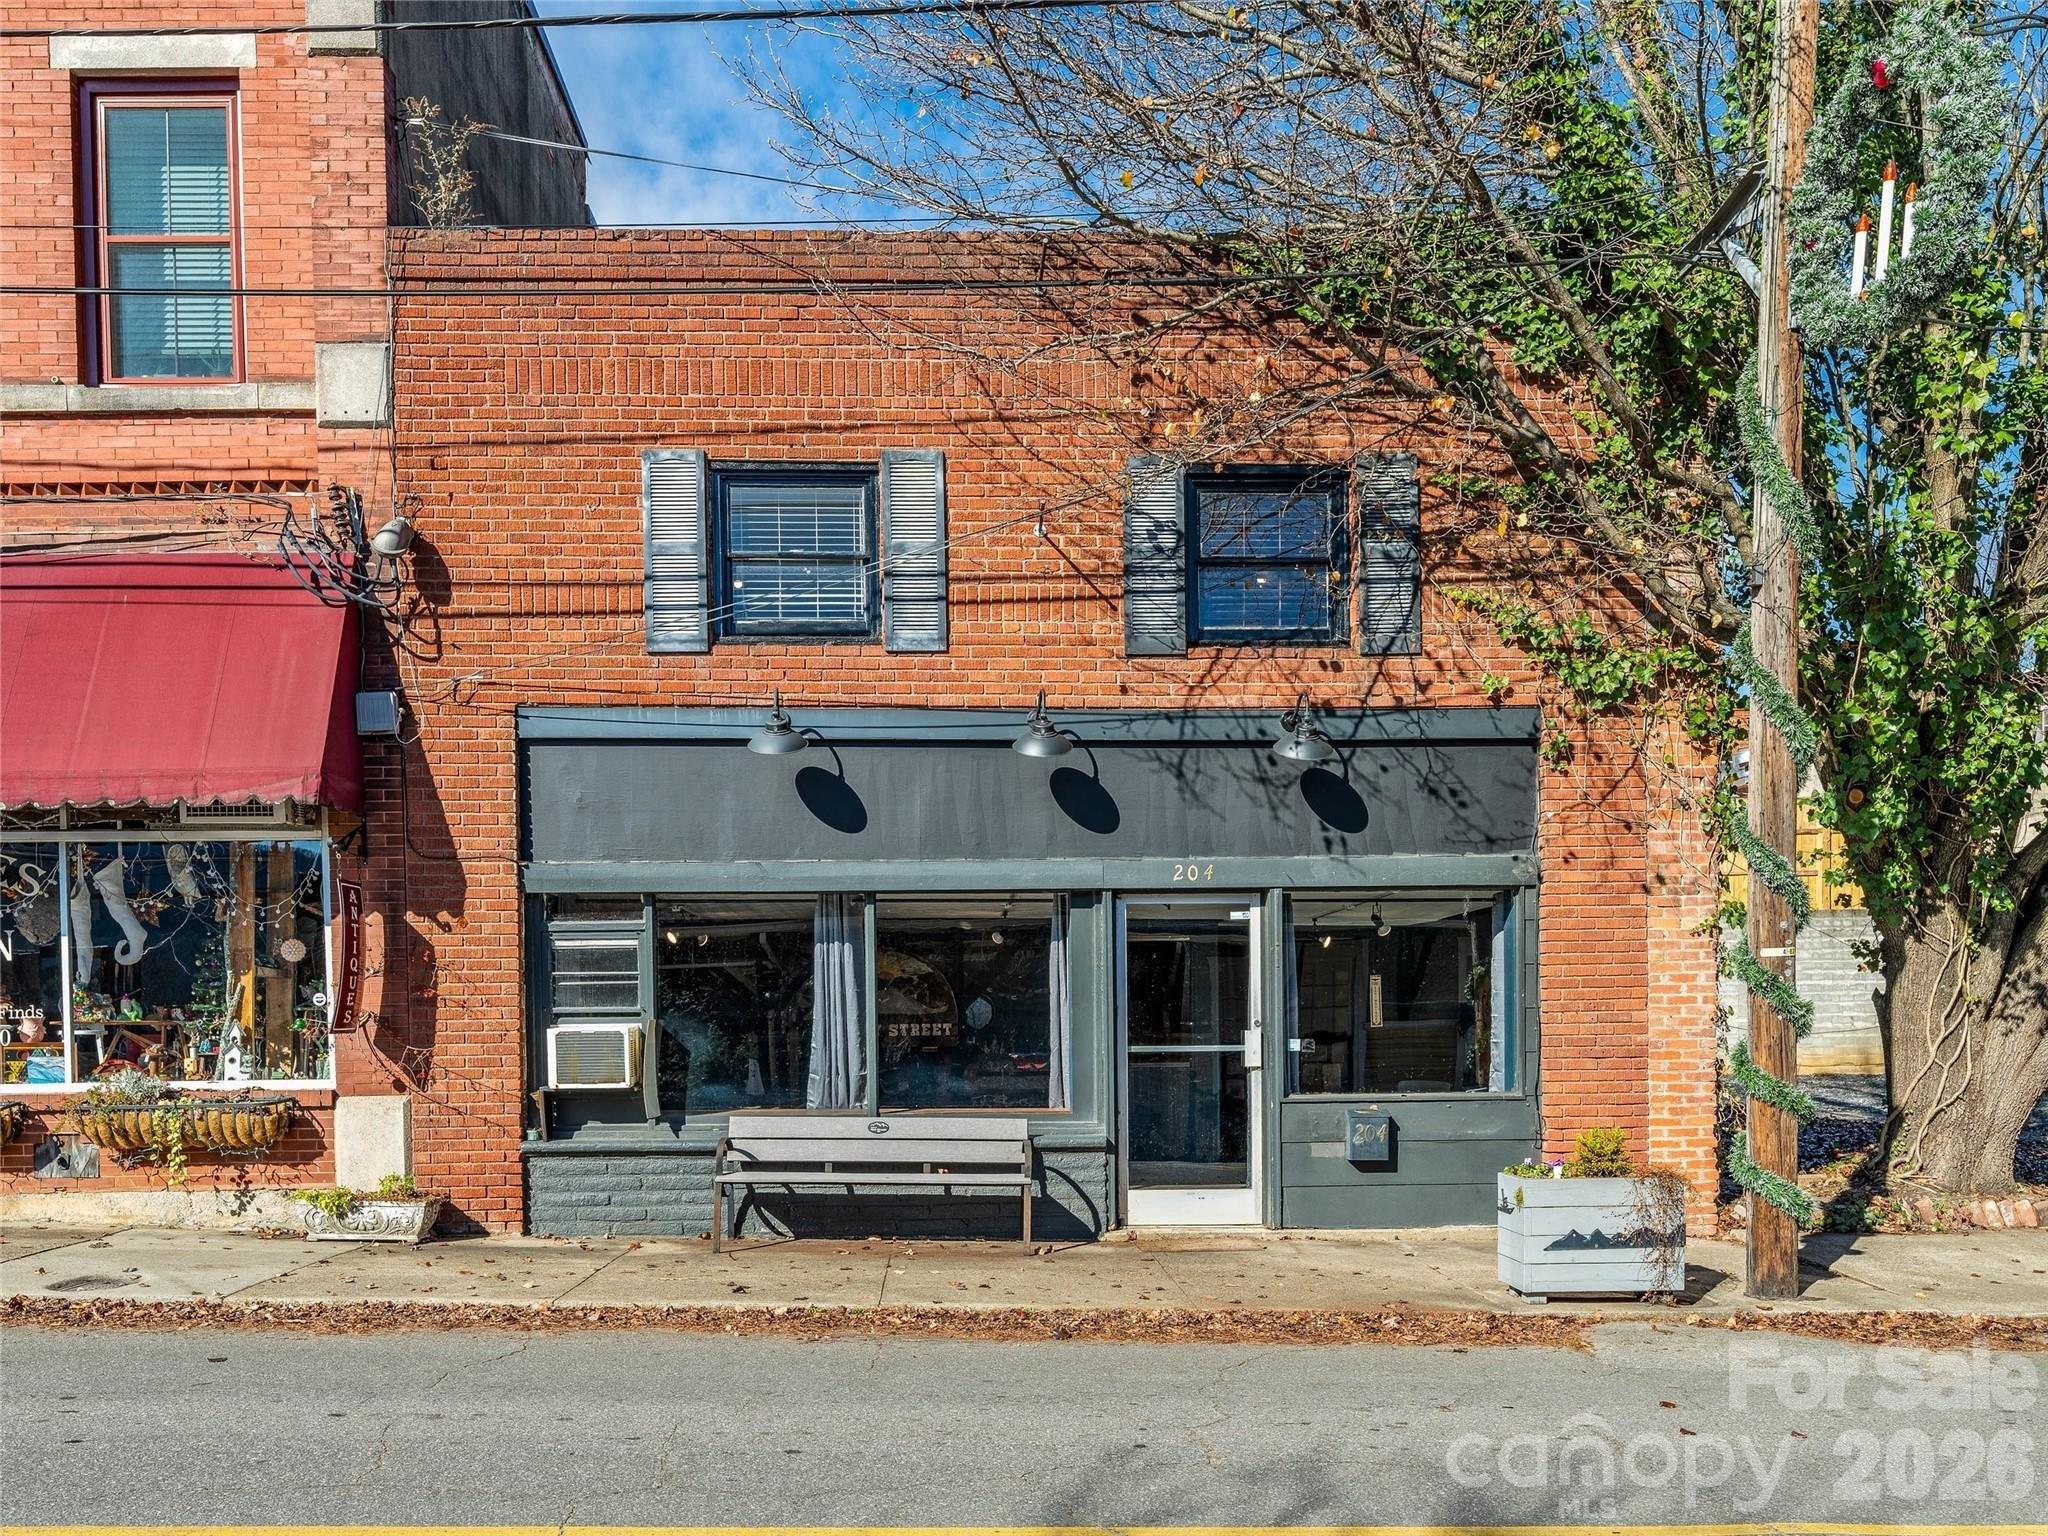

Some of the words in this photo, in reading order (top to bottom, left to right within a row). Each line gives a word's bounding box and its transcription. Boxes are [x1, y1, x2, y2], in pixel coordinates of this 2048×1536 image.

[1173, 864, 1214, 881] 204
[343, 889, 359, 1024] ANTIQUES
[0, 1004, 44, 1020] Finds
[888, 1023, 953, 1037] STREET
[1352, 1123, 1388, 1144] 204
